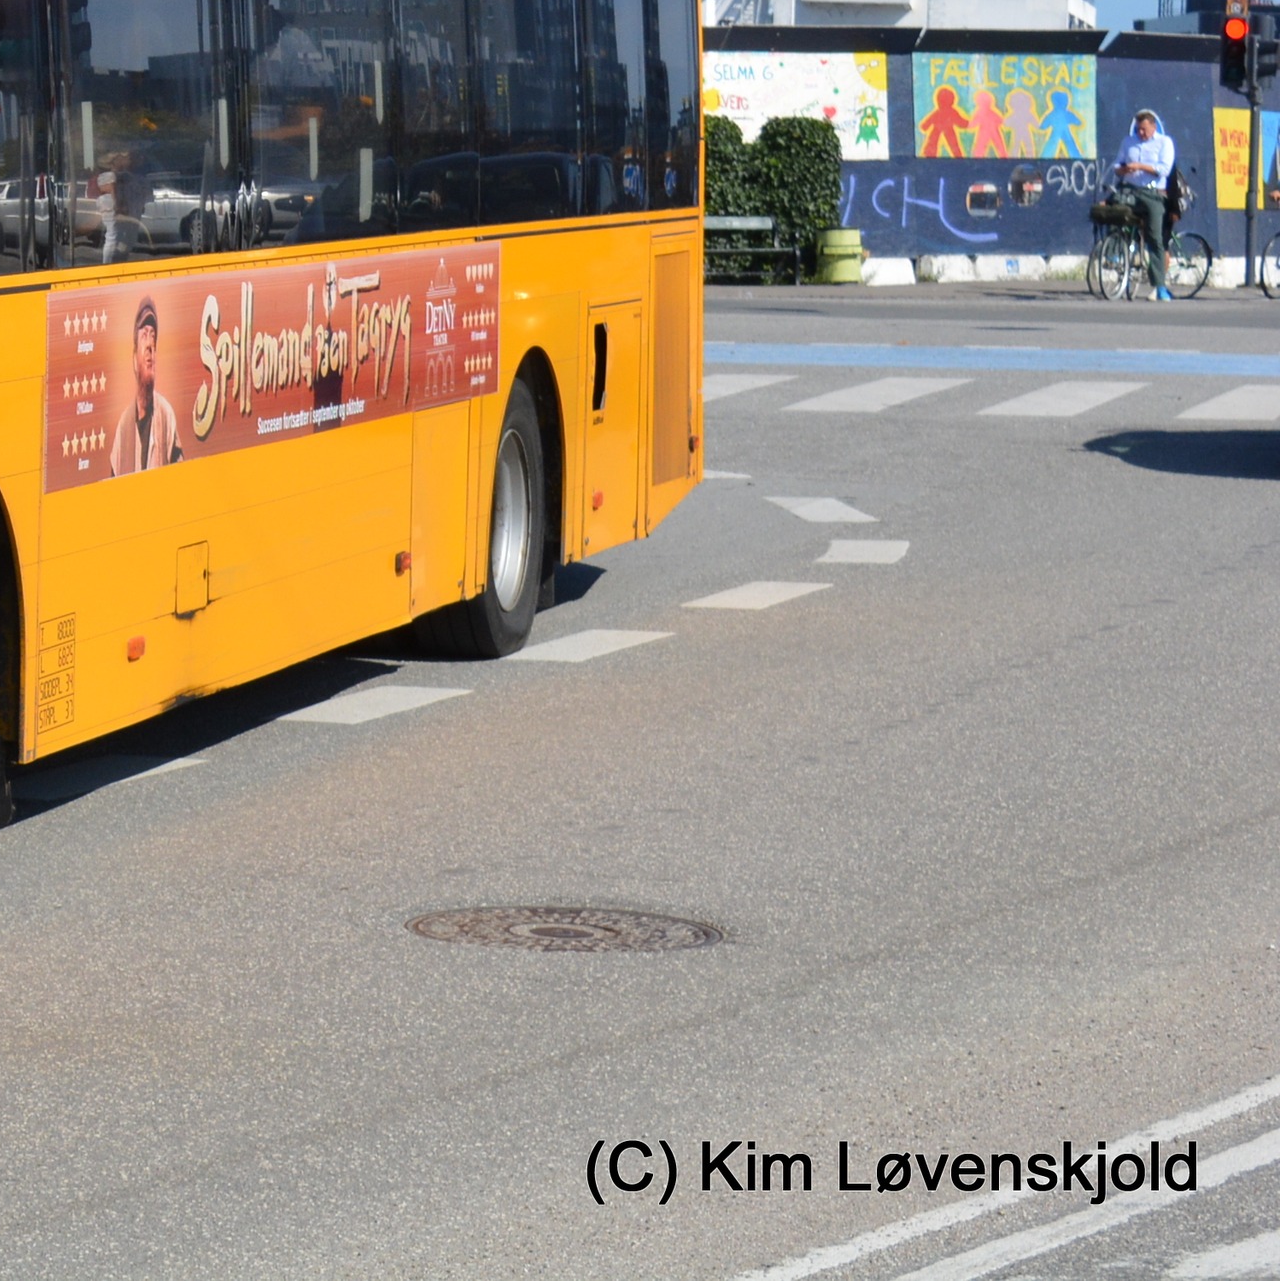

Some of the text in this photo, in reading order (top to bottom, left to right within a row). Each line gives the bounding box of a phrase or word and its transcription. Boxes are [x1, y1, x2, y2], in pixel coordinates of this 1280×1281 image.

[714, 64, 755, 81] SELMA
[193, 281, 314, 437] Spillemand
[257, 417, 282, 435] Succesen
[283, 410, 309, 430] fortsætter
[313, 402, 339, 427] september
[339, 404, 346, 422] og
[346, 396, 365, 416] oktober
